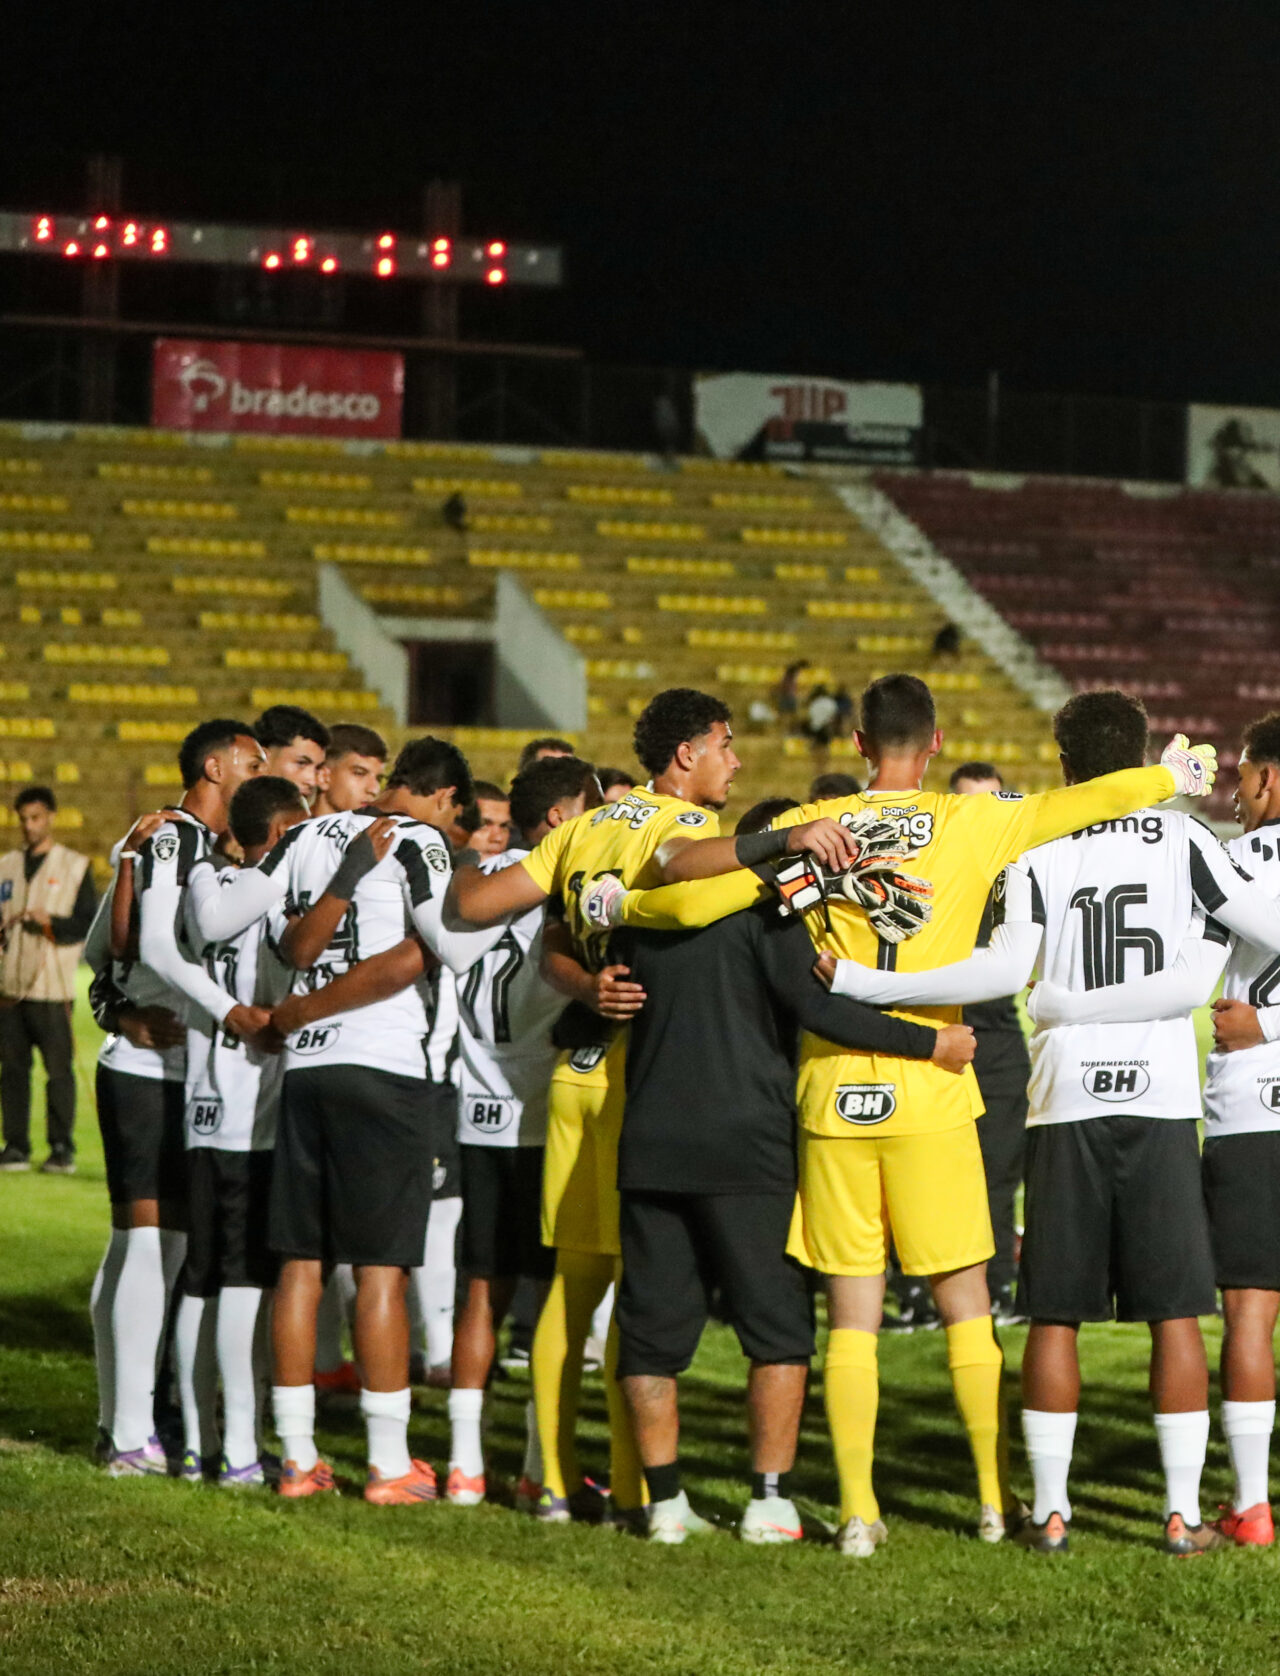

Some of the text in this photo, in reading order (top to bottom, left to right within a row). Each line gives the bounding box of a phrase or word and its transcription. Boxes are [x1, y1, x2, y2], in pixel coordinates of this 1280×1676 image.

[231, 380, 380, 420] bradesco
[882, 805, 918, 816] banco
[1070, 883, 1164, 992] 16
[296, 1029, 330, 1050] BH
[1093, 1069, 1137, 1093] BH
[194, 1105, 218, 1126] BH
[472, 1102, 503, 1125] BH
[844, 1093, 884, 1116] BH
